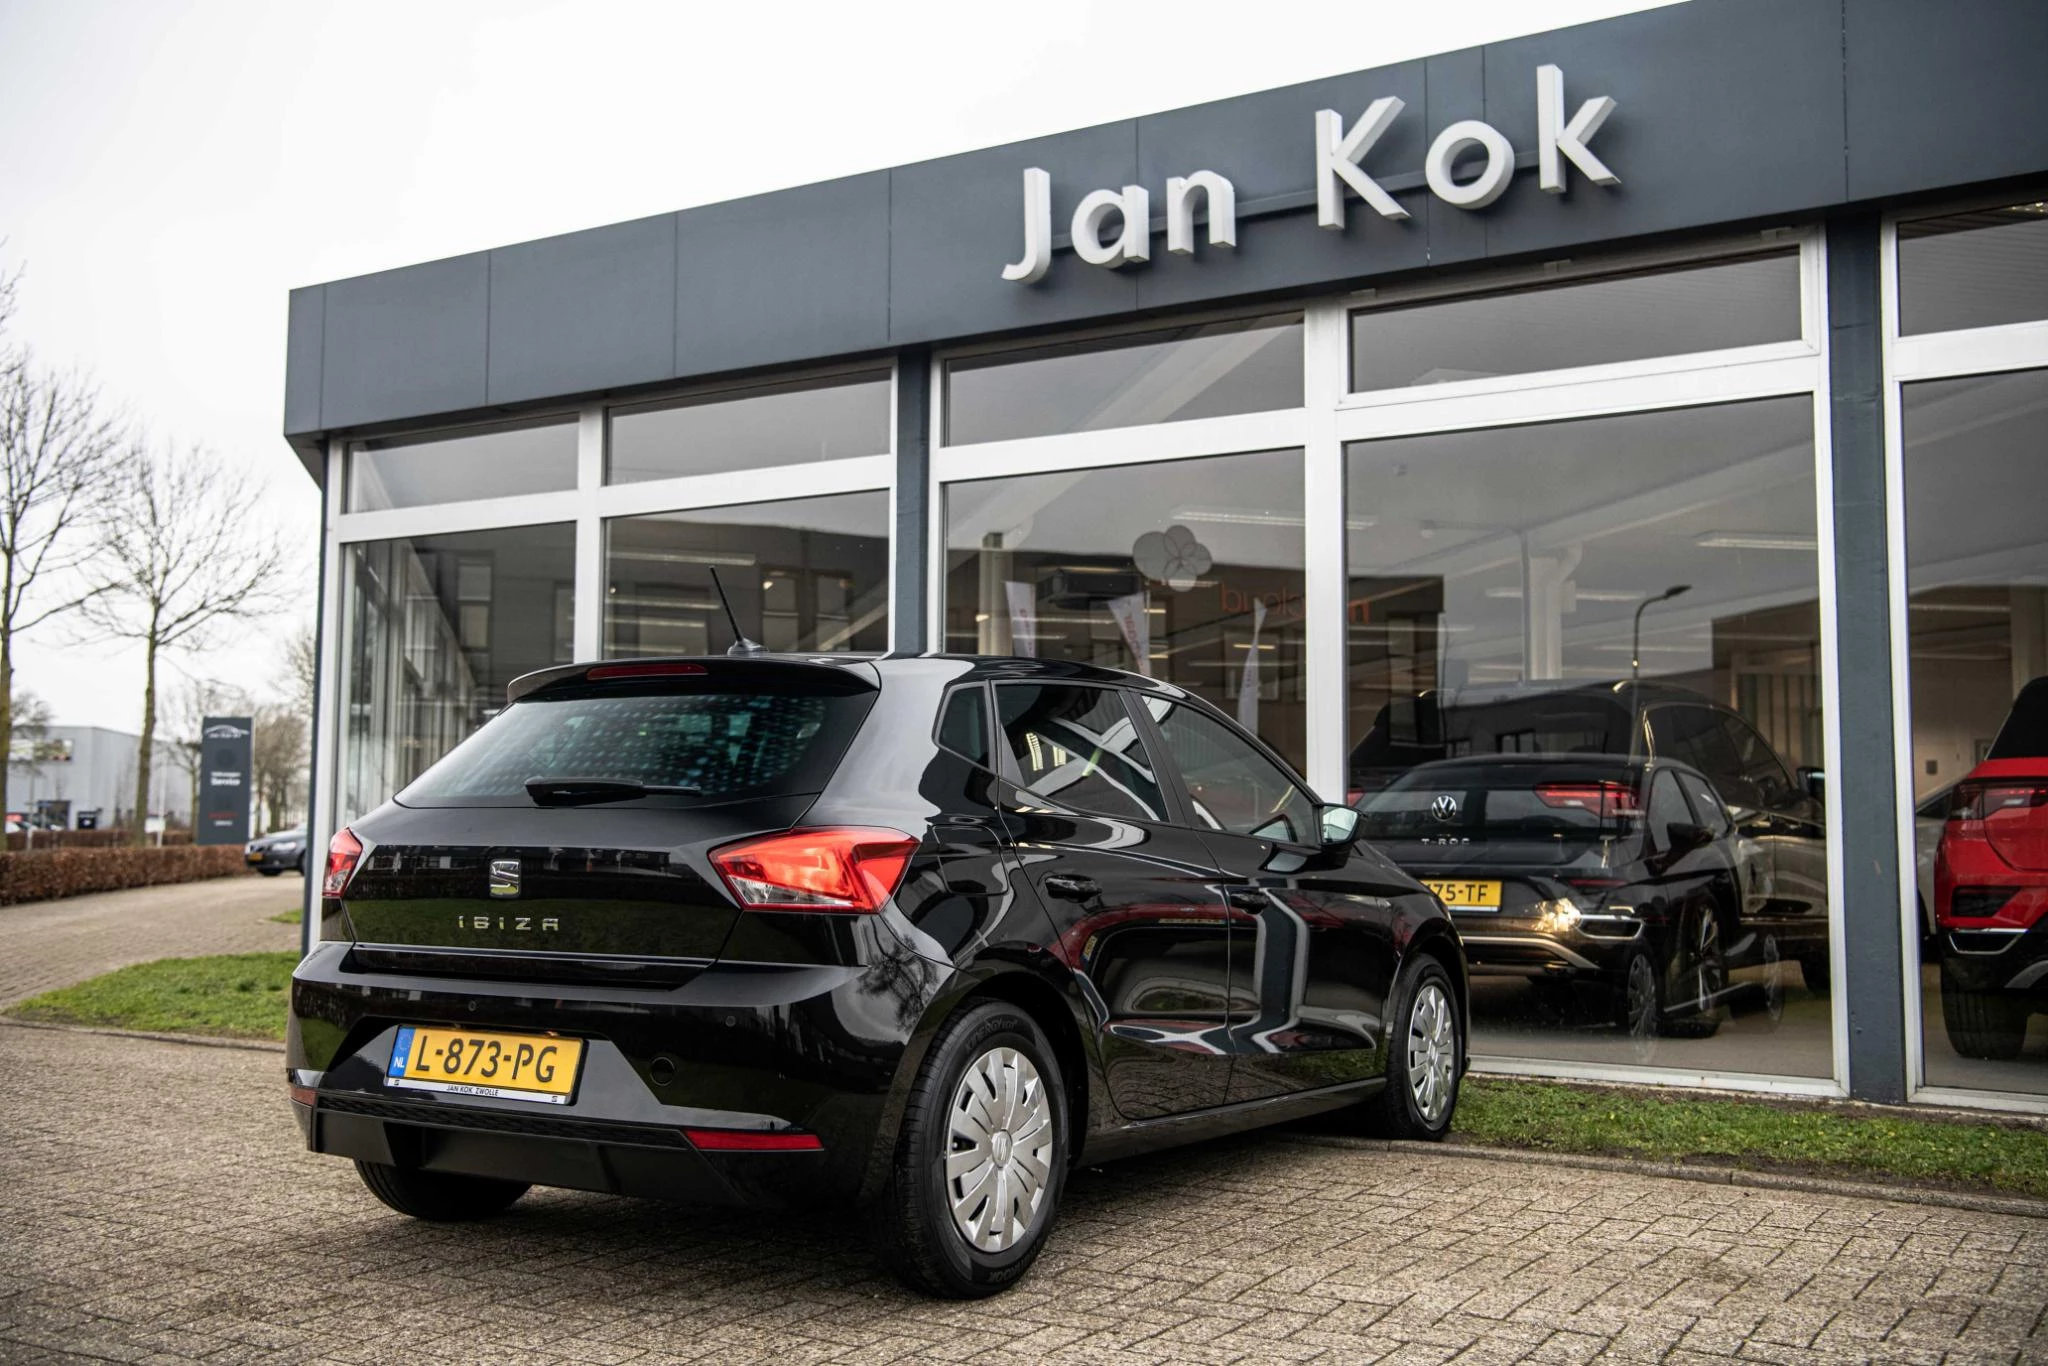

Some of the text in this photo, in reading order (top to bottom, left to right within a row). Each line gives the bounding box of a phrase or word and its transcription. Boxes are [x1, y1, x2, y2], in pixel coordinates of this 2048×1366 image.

[1001, 63, 1622, 285] Jan Kok
[1426, 883, 1489, 902] 75-TF
[458, 915, 559, 931] IBIZA
[393, 1055, 405, 1069] NL
[415, 1034, 558, 1083] L-873-PG
[446, 1085, 499, 1097] JAN KOK ZWOLLE
